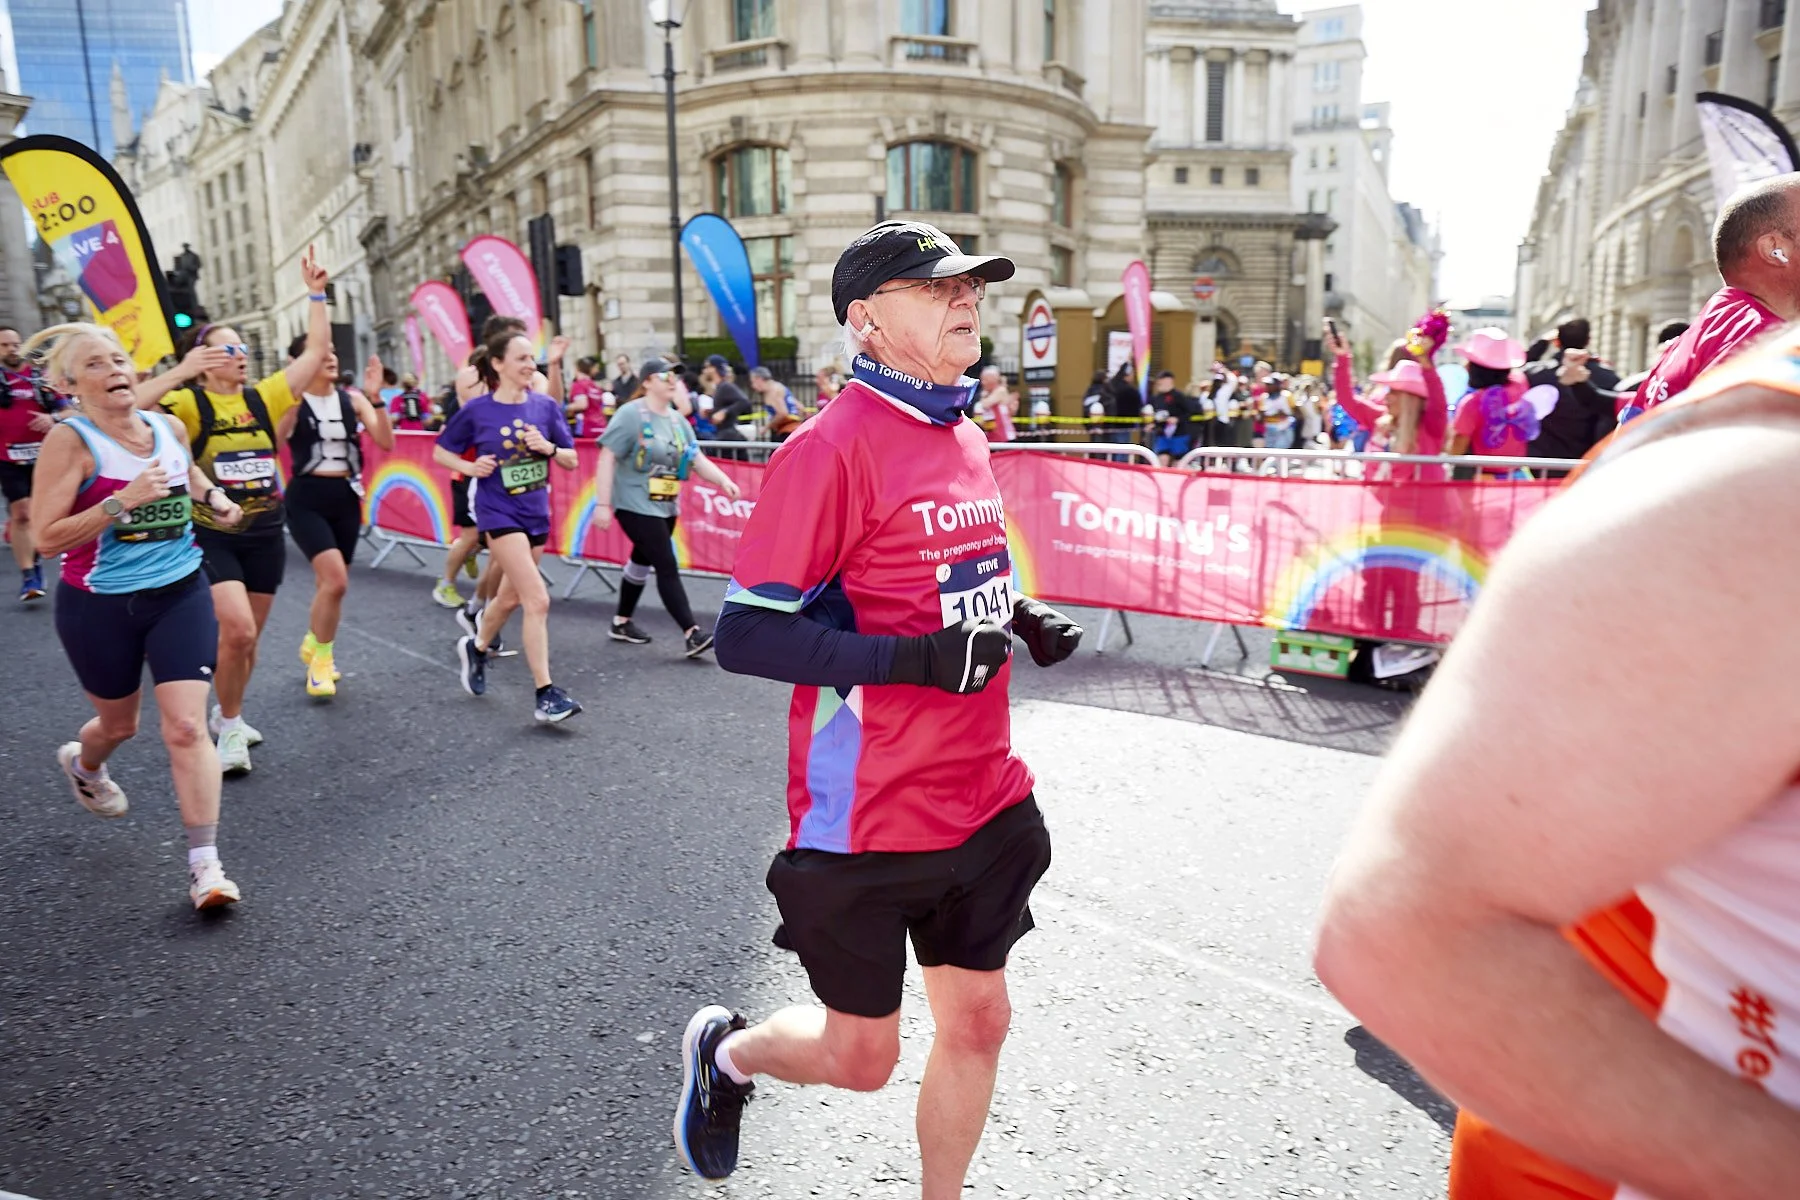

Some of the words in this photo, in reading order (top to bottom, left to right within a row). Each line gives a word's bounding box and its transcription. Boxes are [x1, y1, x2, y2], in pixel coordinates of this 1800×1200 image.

[38, 195, 95, 231] 2:00
[855, 355, 876, 372] Team
[879, 363, 934, 390] Tommy's
[222, 461, 272, 476] PACER
[511, 464, 543, 482] 6213
[1052, 491, 1250, 555] Tommy's
[919, 549, 940, 561] The
[943, 540, 981, 559] pregnancy
[982, 536, 993, 547] and
[977, 558, 999, 575] STEVE
